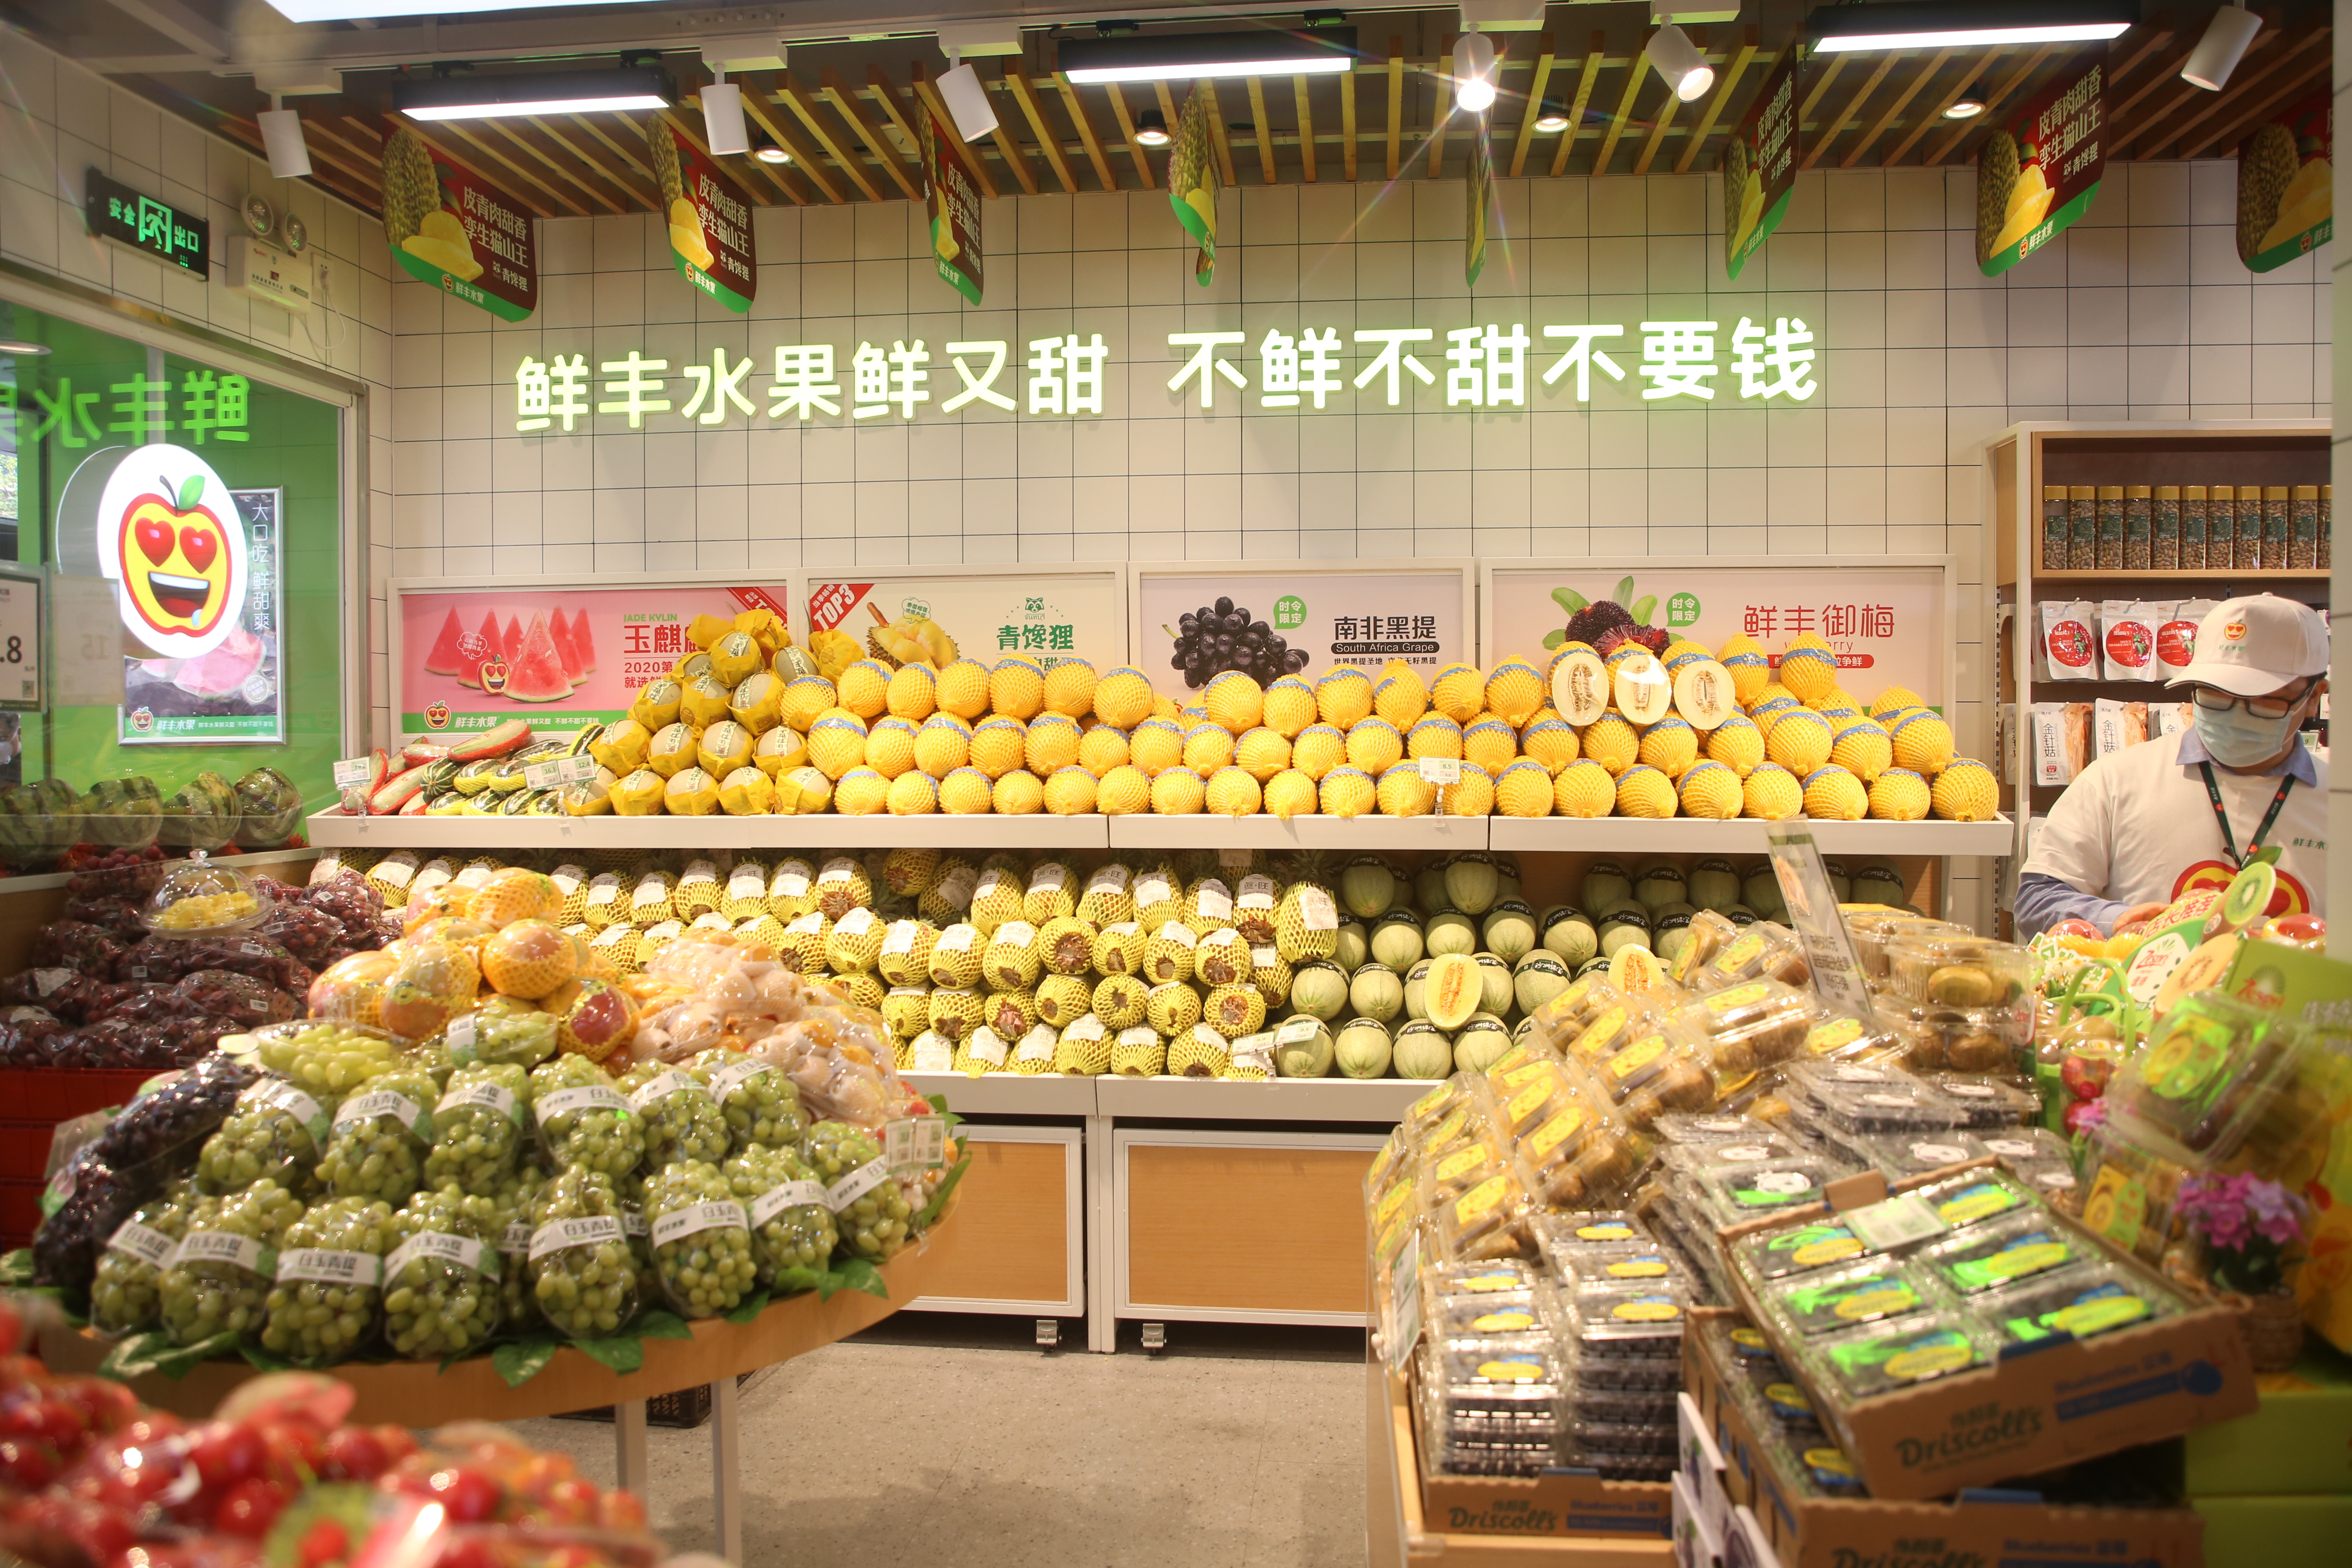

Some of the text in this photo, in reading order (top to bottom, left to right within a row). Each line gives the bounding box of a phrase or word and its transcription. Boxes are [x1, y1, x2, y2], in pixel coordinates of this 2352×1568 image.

[1758, 71, 1792, 147] 皮青肉甜香
[2039, 64, 2101, 142] 皮青肉甜香
[2039, 99, 2101, 172] 孪生猫山王
[2073, 141, 2098, 175] 青馋狸
[464, 186, 527, 241] 皮青肉甜香
[699, 173, 747, 230] 皮青肉甜香
[110, 196, 199, 252] 安全 出口
[698, 203, 750, 257] 孪生猫山王
[2029, 220, 2054, 250] 鲜丰水果
[2313, 224, 2333, 245] 鲜丰
[464, 216, 528, 268] 孪生猫山王
[502, 268, 528, 292] 青馋狸
[727, 257, 749, 282] 青馋狸
[939, 260, 959, 285] 鲜丰水果
[456, 282, 484, 304] 鲜丰水果
[695, 271, 716, 294] 鲜丰水果
[516, 316, 1817, 431] 鲜丰水果鲜又甜 不鲜不甜不要钱
[252, 503, 270, 630] 大口吃 鲜甜爽
[812, 585, 835, 608] 当季畅销
[813, 584, 855, 630] TOP3
[907, 602, 928, 612] 泰国榴莲
[1279, 601, 1302, 612] 时令
[1672, 597, 1695, 609] 时令
[624, 613, 677, 622] JADE KYLIN
[905, 608, 927, 618] 优质产区
[1279, 613, 1302, 624] 限定
[1672, 610, 1695, 622] 限定
[1744, 604, 1895, 639] 鲜丰御梅
[996, 624, 1074, 650] 青馋狸
[1334, 615, 1436, 640] 南非黑提
[1334, 657, 1383, 665] 世界黑提圣地
[1336, 643, 1434, 654] South Africa Grape
[624, 661, 673, 674] 2020第
[156, 720, 196, 731] 鲜丰水果
[454, 716, 497, 728] 鲜丰水果
[2043, 723, 2056, 757] 金针菇
[2102, 720, 2116, 753] 金针菇
[2292, 837, 2328, 851] 鲜丰水
[2141, 894, 2218, 941] 店长推荐
[563, 1218, 615, 1236] 白玉青提
[1896, 1409, 2043, 1470] Driscoll's
[1449, 1506, 1558, 1531] Driscoll's
